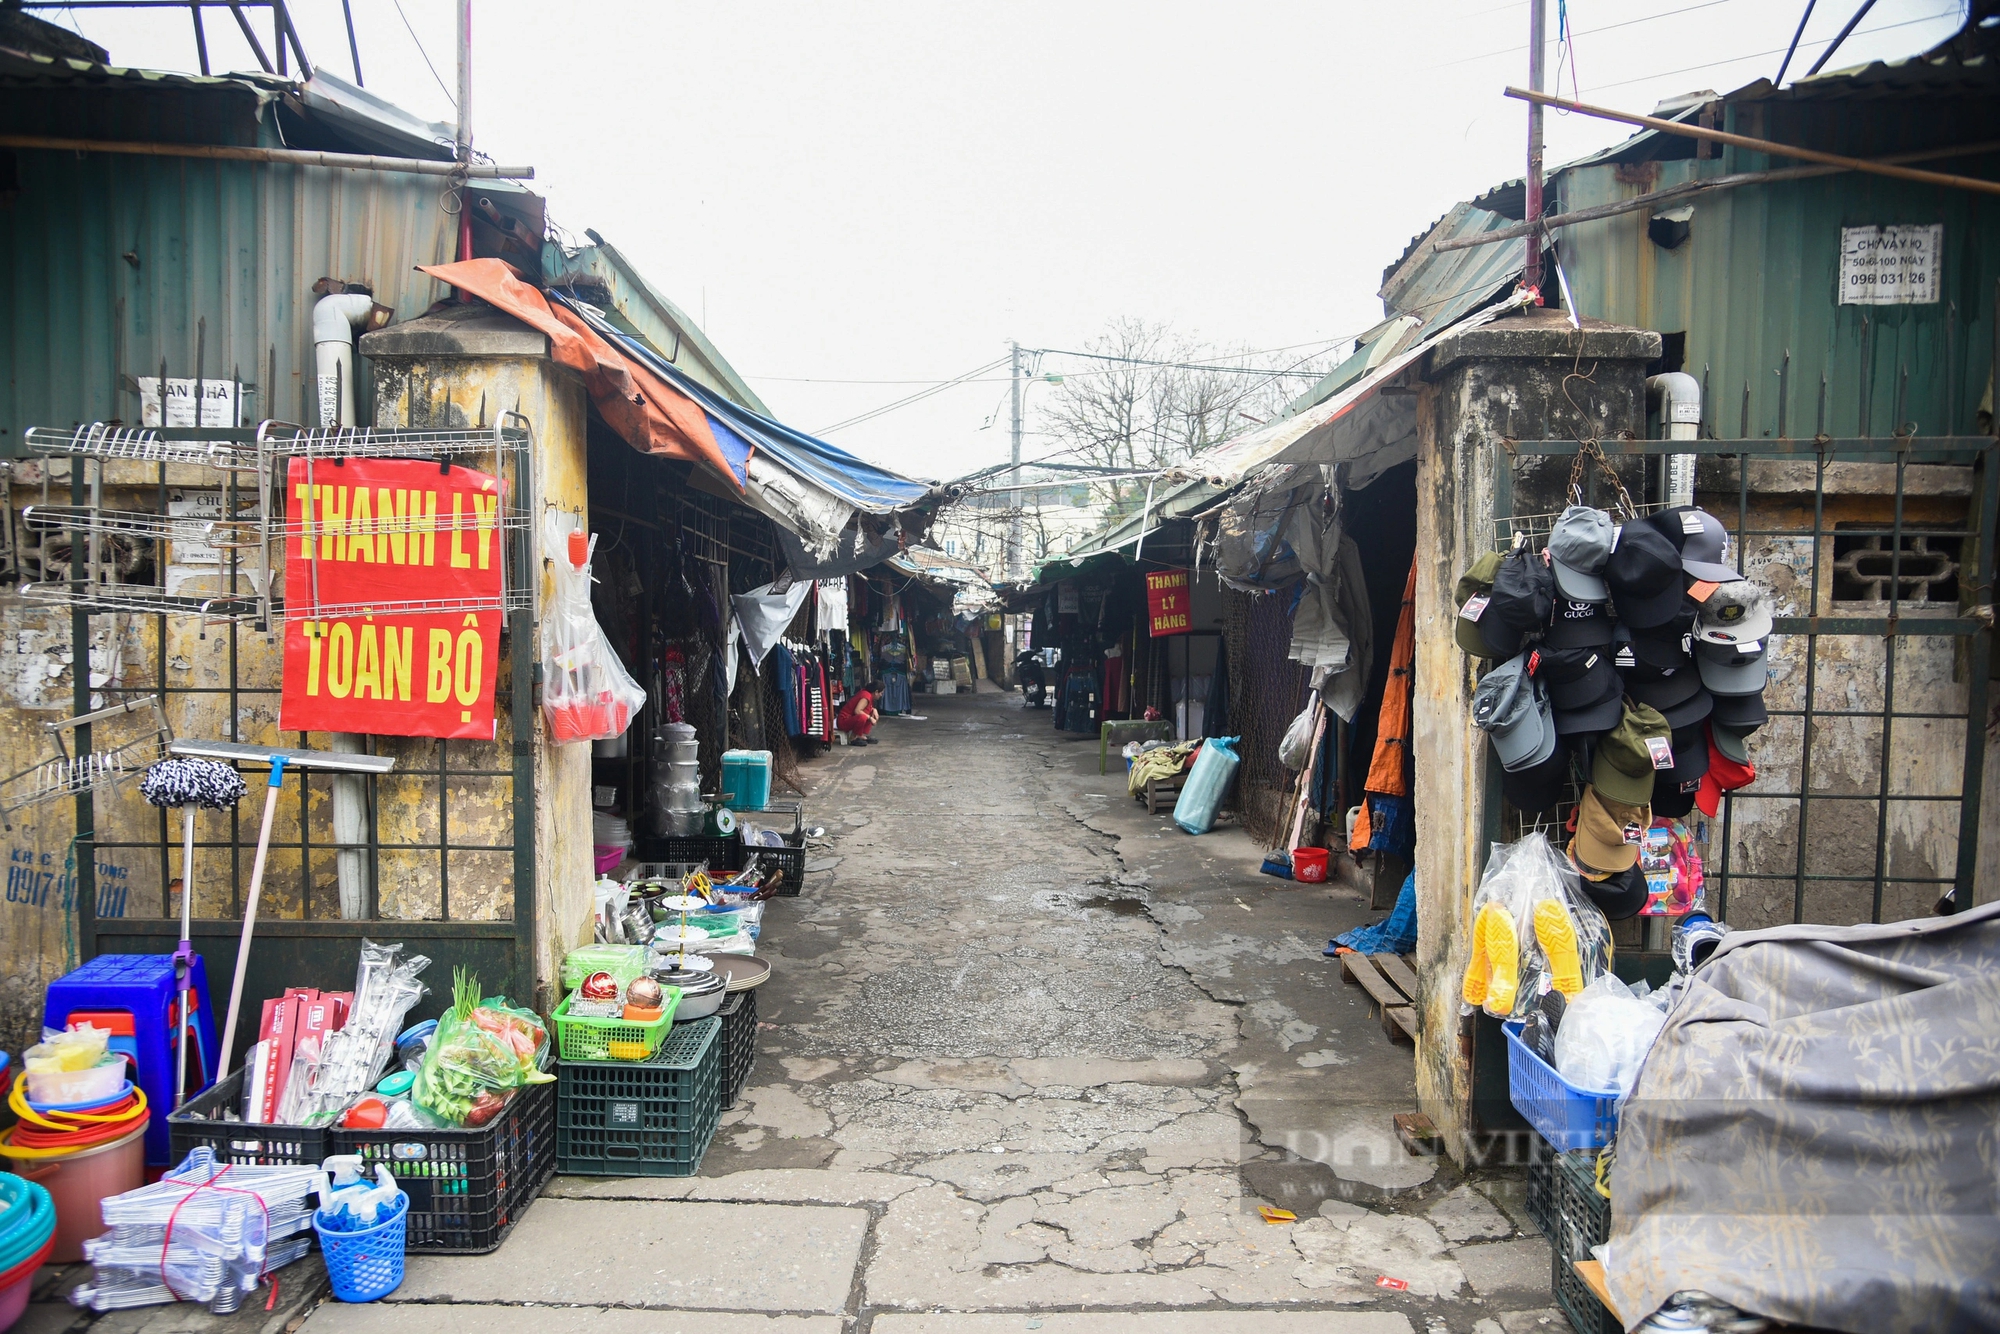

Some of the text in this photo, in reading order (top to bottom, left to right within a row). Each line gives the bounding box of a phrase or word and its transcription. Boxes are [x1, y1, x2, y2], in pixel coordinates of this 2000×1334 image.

[1852, 257, 1897, 267] 50-6-100
[1851, 272, 1926, 285] 096 031 26
[296, 480, 497, 570] THANH LÝ
[1148, 573, 1187, 590] THANH
[1162, 594, 1176, 610] LÝ
[1154, 613, 1187, 630] HÀNG
[303, 607, 484, 724] TOÀN BỘ
[95, 861, 128, 880] ONG
